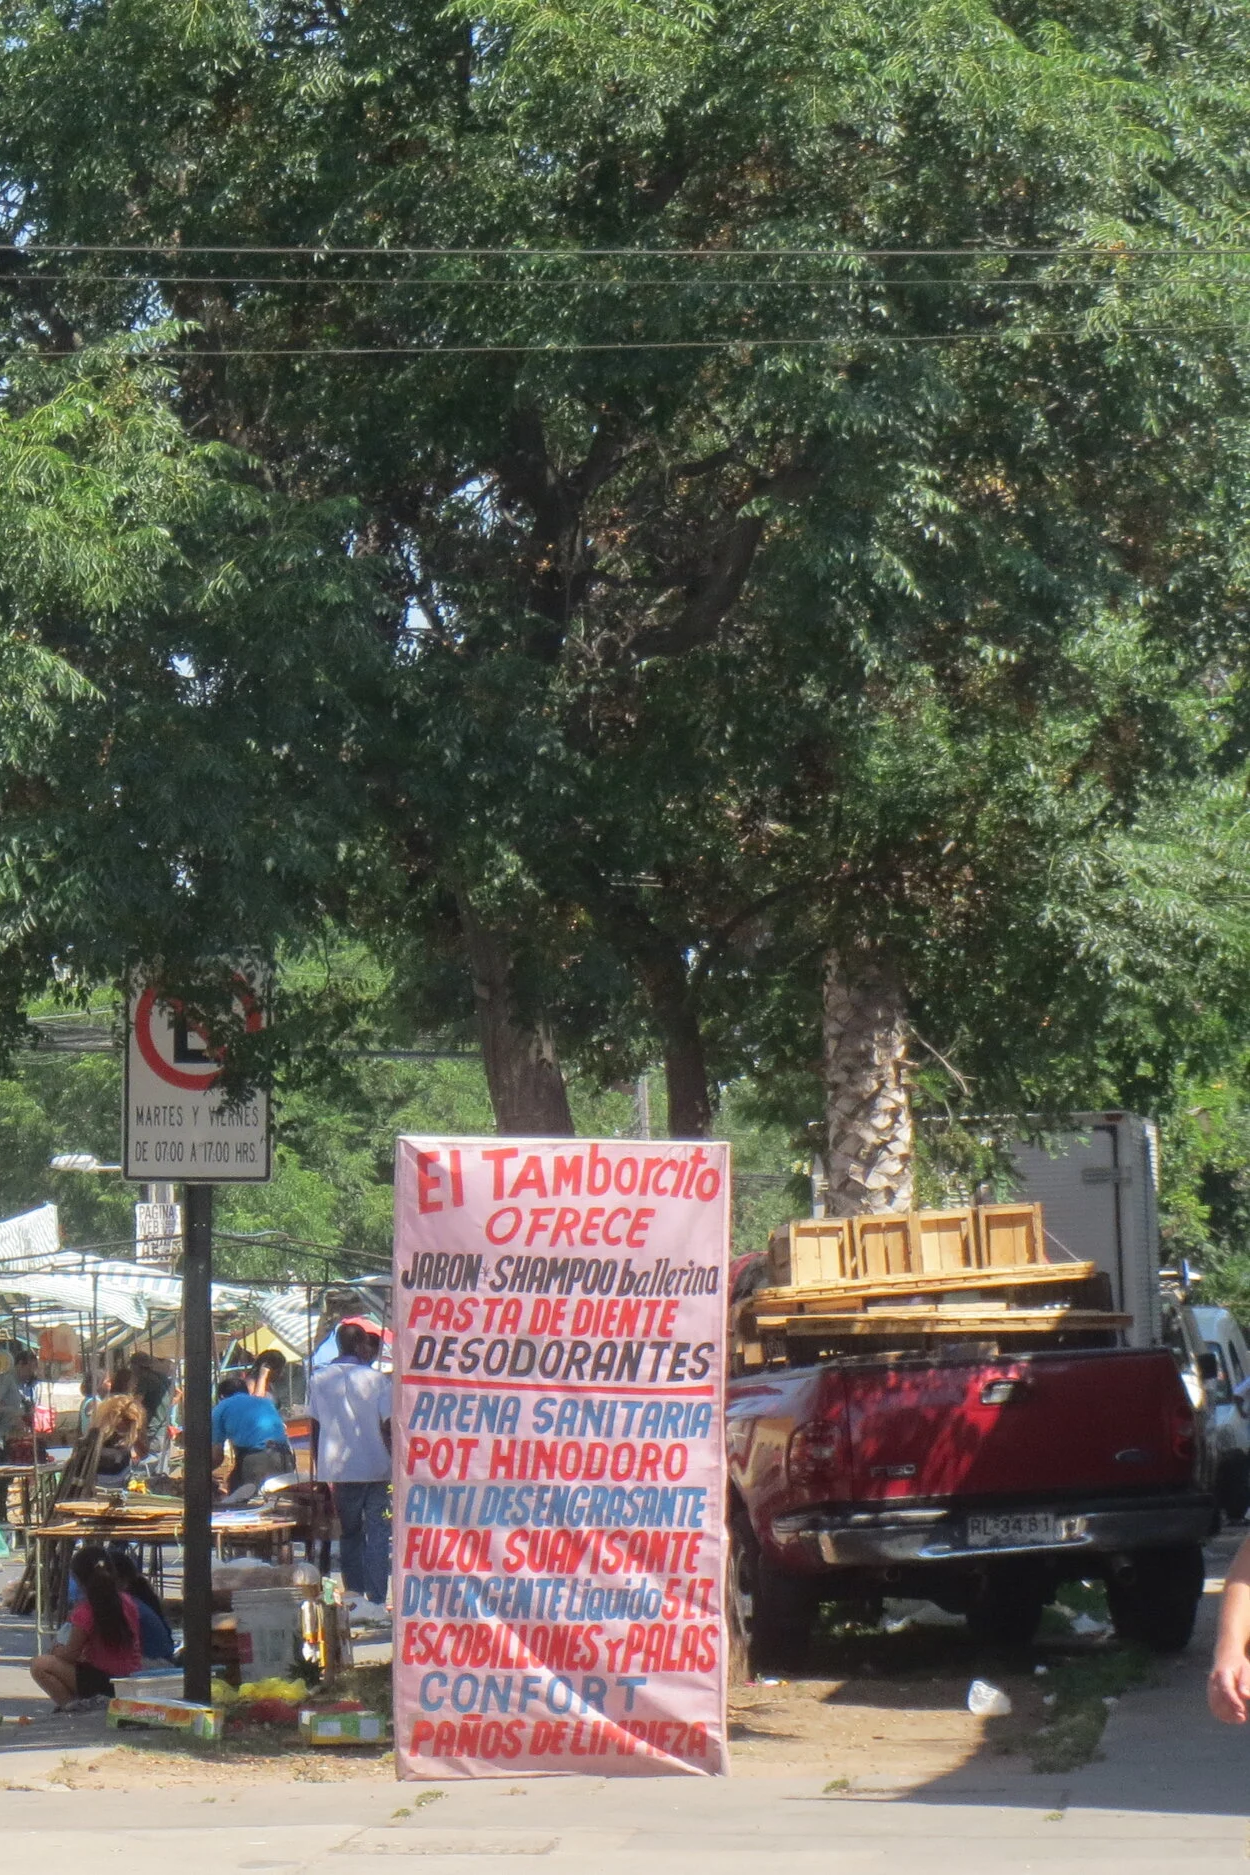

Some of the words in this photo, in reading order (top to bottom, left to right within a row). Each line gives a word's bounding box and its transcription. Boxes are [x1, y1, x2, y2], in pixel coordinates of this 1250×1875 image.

[136, 1106, 183, 1127] MARTES
[192, 1106, 200, 1127] Y
[209, 1106, 259, 1127] VIERNES
[135, 1141, 149, 1162] DE
[155, 1142, 184, 1162] 07:00
[190, 1143, 197, 1162] A
[204, 1142, 230, 1162] 17:00
[485, 1207, 656, 1248] OFRECE
[401, 1252, 483, 1292] JABON
[489, 1255, 617, 1295] SHAMPOO
[616, 1258, 718, 1297] ballerina
[407, 1296, 523, 1335] PASTA
[528, 1298, 567, 1337] DE
[570, 1299, 679, 1338] DIENTE
[410, 1336, 714, 1382] DESODORANTES
[409, 1392, 521, 1434] ARENA
[532, 1398, 712, 1439] SANITARIA
[406, 1437, 479, 1480] POT
[489, 1438, 688, 1482] HINODORO
[403, 1528, 492, 1573] FUZOL
[502, 1529, 702, 1575] SUAVISANTE
[401, 1575, 565, 1621] DETERGENTE
[402, 1622, 603, 1671] ESCOBILLONES
[620, 1623, 719, 1673] PALAS
[419, 1671, 647, 1715] CONFORT
[409, 1713, 526, 1759] PAÑOS
[529, 1720, 569, 1757] DE
[570, 1720, 707, 1758] LIMPIEZA
